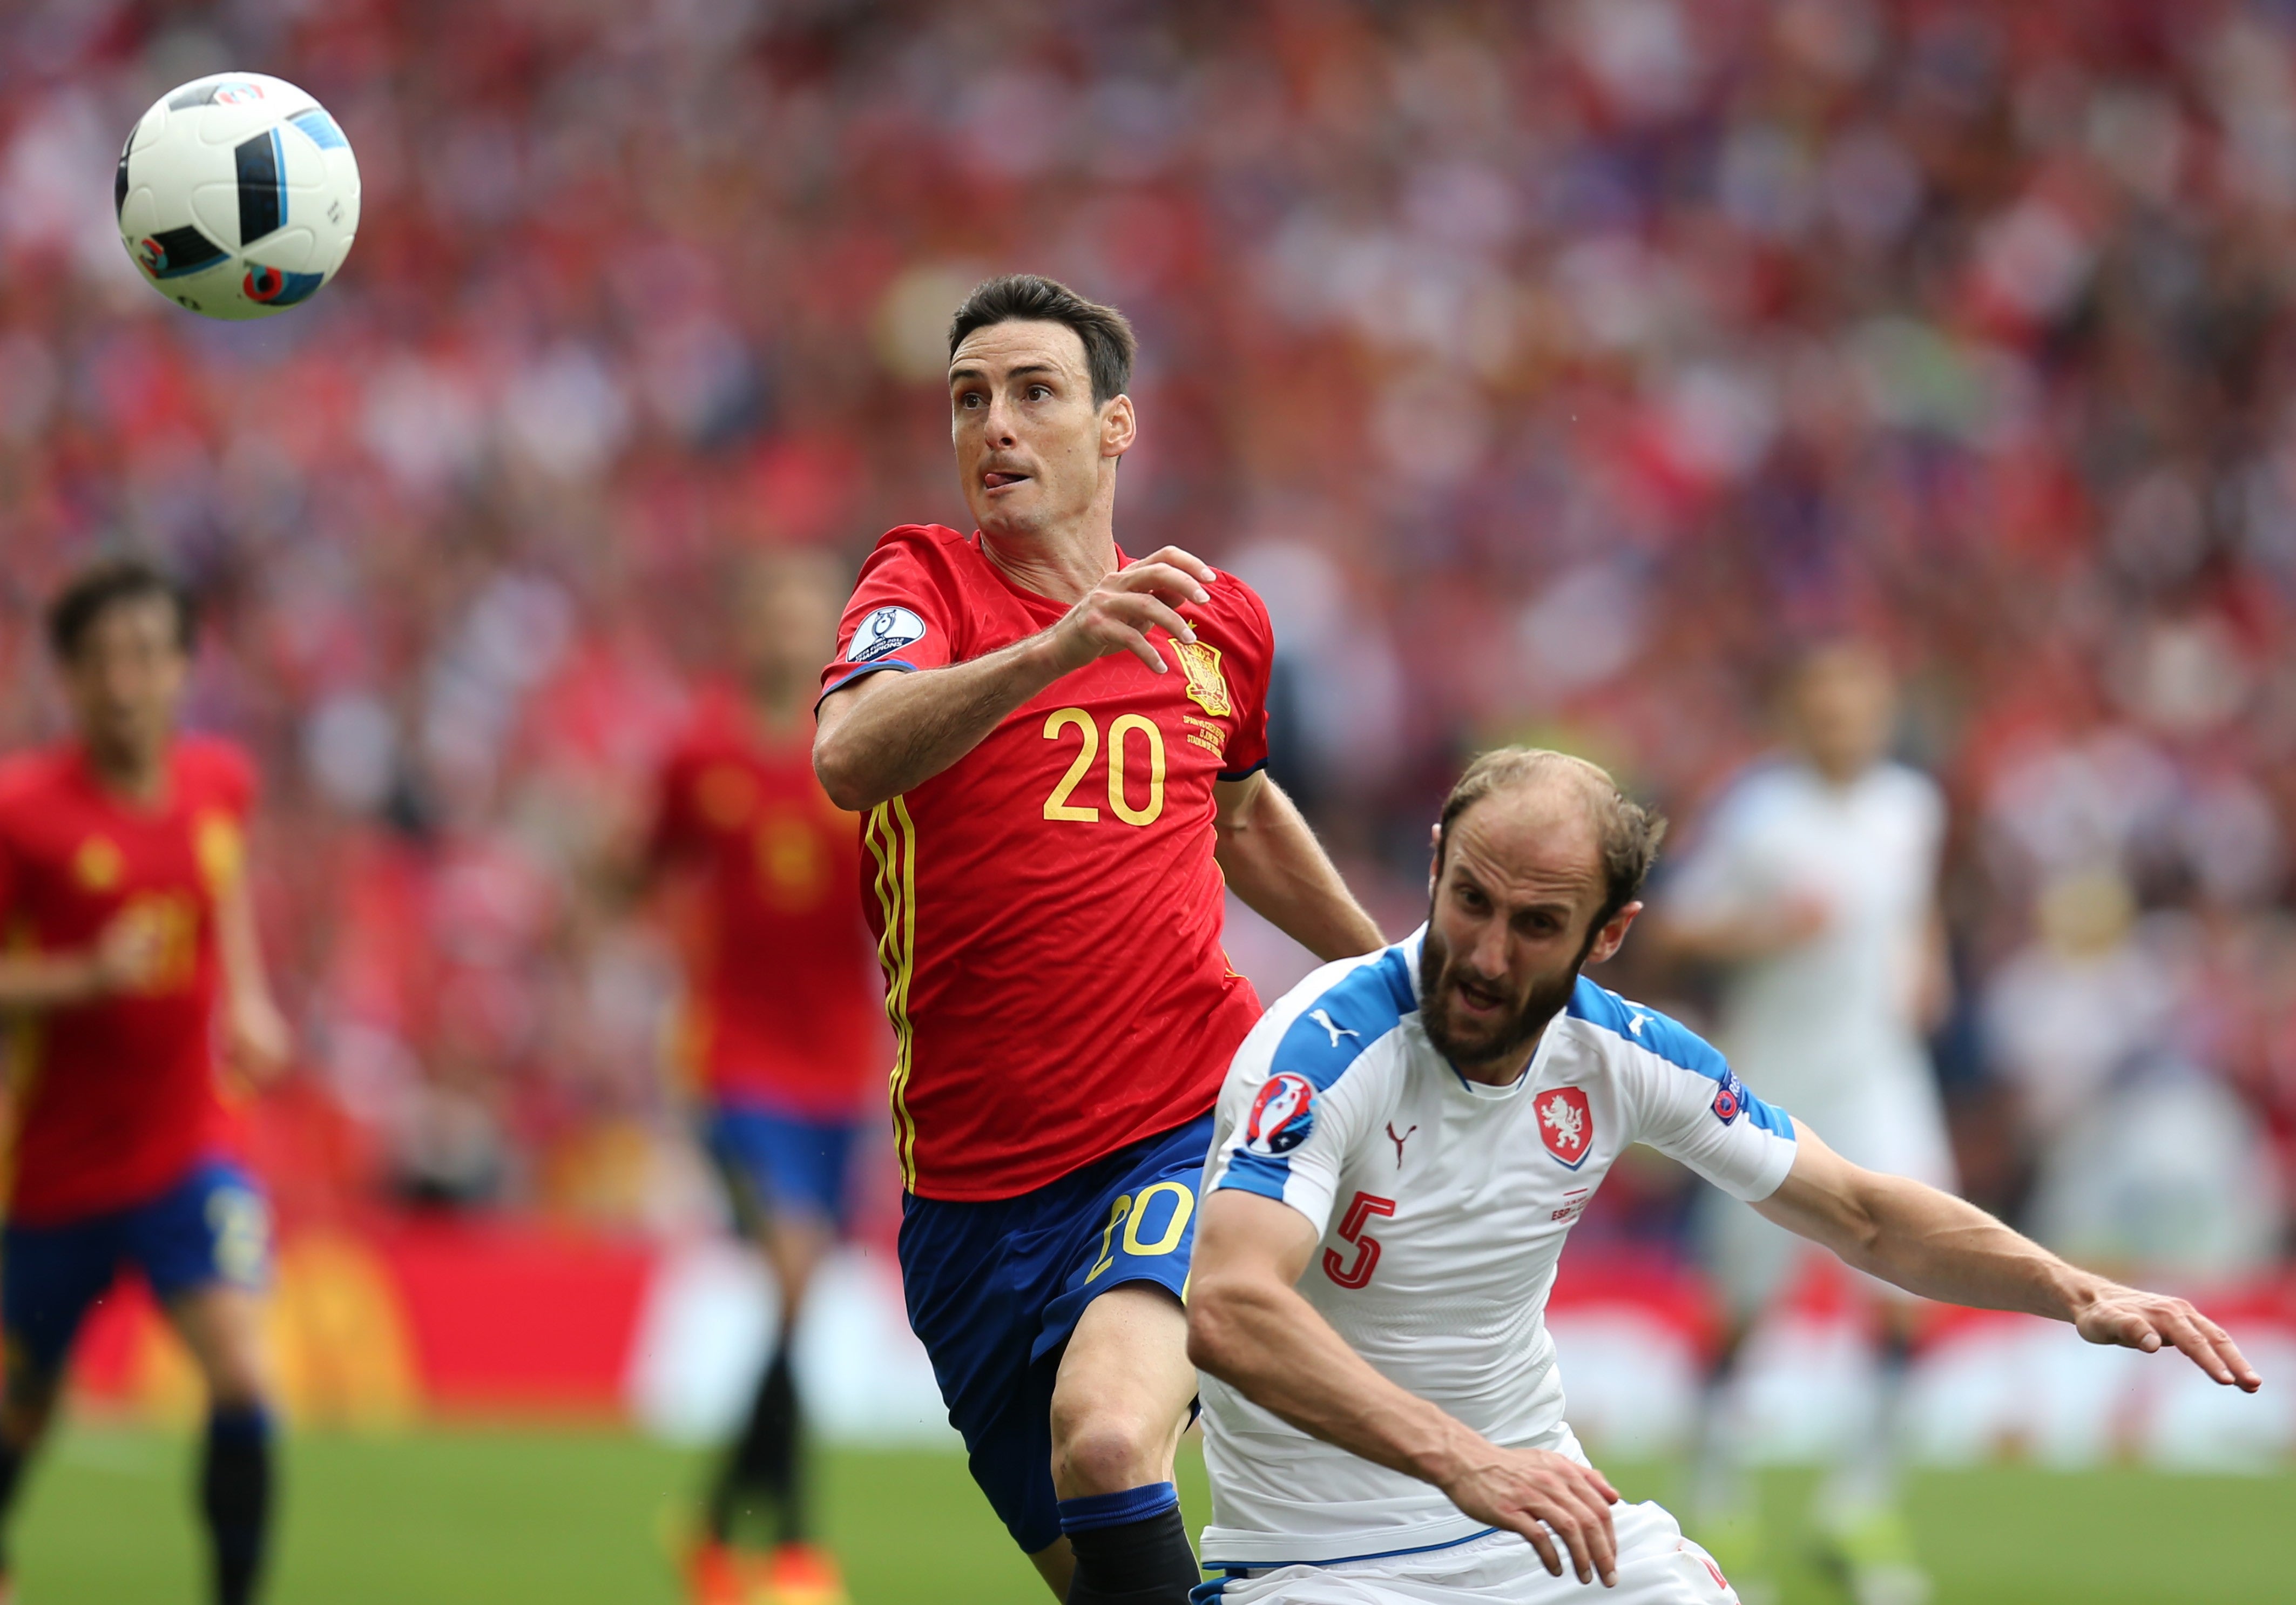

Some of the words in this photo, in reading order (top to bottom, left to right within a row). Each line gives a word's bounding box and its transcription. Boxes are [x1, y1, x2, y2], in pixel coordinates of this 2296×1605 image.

[1043, 707, 1166, 826] 20
[1084, 1181, 1194, 1285] 20
[1322, 1191, 1396, 1290] 5
[1551, 1208, 1570, 1220] ESP
